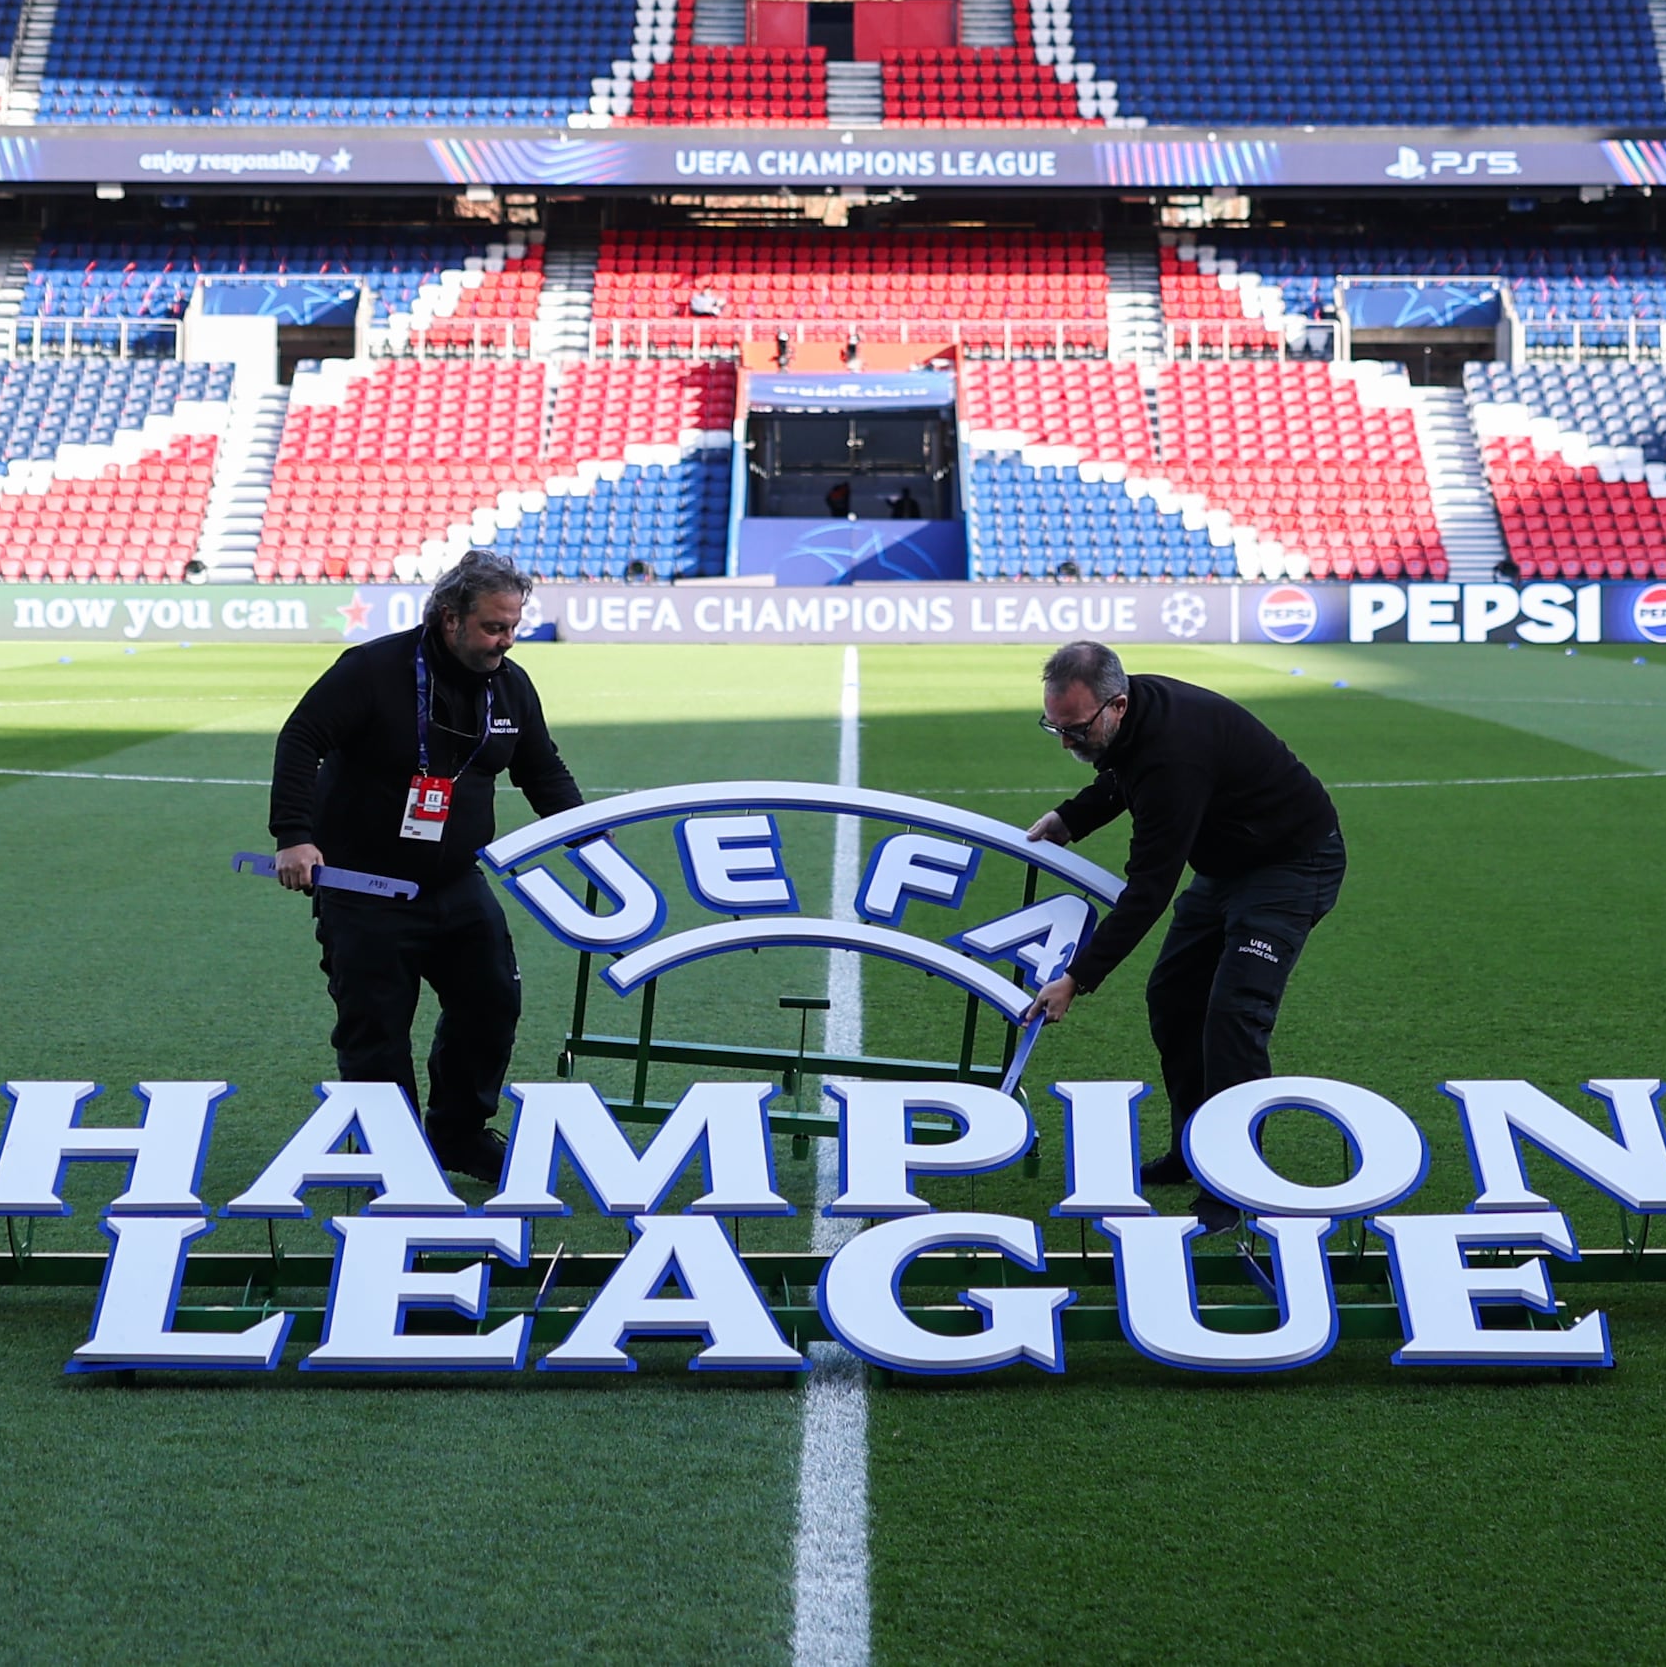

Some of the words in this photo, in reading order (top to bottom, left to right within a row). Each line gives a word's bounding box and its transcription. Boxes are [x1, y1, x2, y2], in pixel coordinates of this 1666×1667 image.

[140, 150, 194, 174] enjoy
[199, 149, 321, 174] responsibly
[675, 150, 753, 175] UEFA
[757, 150, 936, 176] CHAMPIONS
[942, 150, 1057, 176] LEAGUE
[1432, 151, 1518, 175] PS5
[15, 597, 121, 629] now
[124, 597, 216, 638] you
[222, 597, 310, 630] can
[566, 596, 681, 632] UEFA
[694, 596, 954, 633] CHAMPIONS
[972, 596, 1137, 632] LEAGUE
[1349, 582, 1601, 644] PEPSI
[503, 812, 1099, 989] UEFA
[1250, 938, 1273, 953] UEFA
[65, 1212, 1614, 1374] LEAGUE
